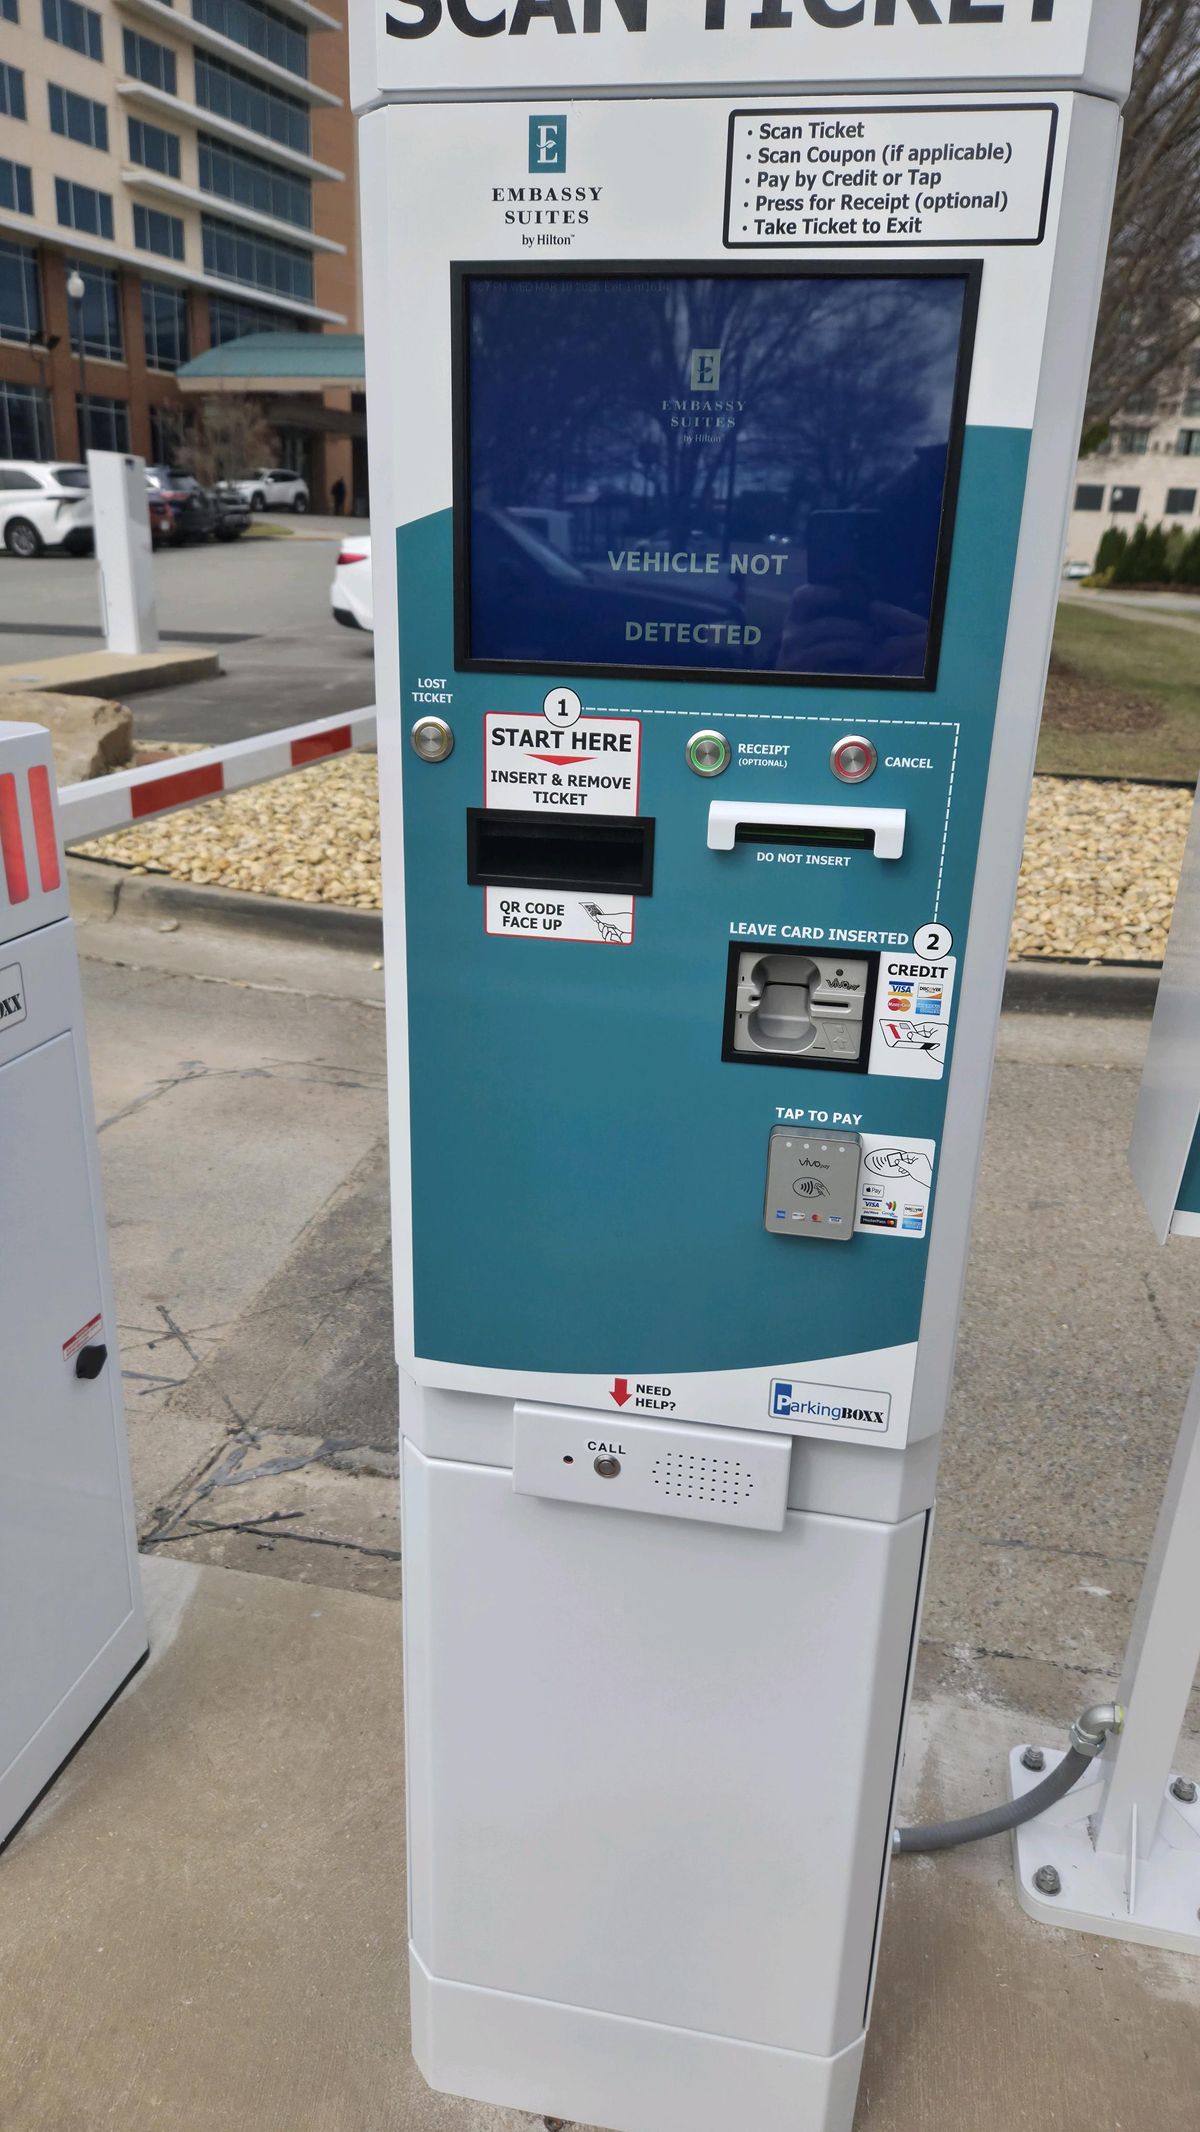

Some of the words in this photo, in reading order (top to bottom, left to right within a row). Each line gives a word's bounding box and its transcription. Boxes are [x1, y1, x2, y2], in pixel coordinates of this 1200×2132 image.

[759, 123, 802, 139] Scan
[809, 121, 865, 138] Ticket
[758, 147, 800, 163] Scan
[807, 145, 876, 166] Coupon
[882, 144, 904, 165] (if
[908, 142, 1013, 165] applicable)
[756, 171, 789, 191] Pay
[796, 170, 817, 191] by
[822, 169, 878, 187] Credit
[883, 173, 903, 187] or
[908, 169, 942, 189] Tap
[492, 187, 603, 201] EMBASSY
[755, 195, 804, 211] Press
[809, 194, 835, 211] for
[841, 193, 910, 213] Receipt
[915, 191, 1008, 213] (optional)
[505, 210, 589, 224] SUITES
[754, 218, 797, 235] Take
[802, 218, 857, 235] Ticket
[863, 218, 881, 234] to
[886, 217, 922, 234] Exit
[522, 234, 535, 248] by
[662, 400, 746, 411] EMBASSY
[671, 416, 736, 428] SUITES
[608, 550, 720, 574] VEHICLE
[730, 553, 789, 576] NOT
[625, 621, 762, 646] DETECTED
[418, 678, 447, 690] LOST
[412, 692, 453, 704] TICKET
[557, 698, 569, 717] 1
[491, 727, 564, 749] START
[572, 732, 632, 752] HERE
[738, 743, 790, 756] RECEIPT
[738, 758, 788, 769] (OPTIONAL)
[885, 757, 933, 769] CANCEL
[490, 770, 547, 786] INSERT
[551, 774, 564, 786] &
[568, 774, 631, 790] REMOVE
[533, 791, 588, 806] TICKET
[757, 852, 774, 862] DO
[778, 854, 803, 864] NOT
[806, 855, 851, 867] INSERT
[500, 900, 520, 915] QR
[525, 902, 565, 916] CODE
[502, 916, 538, 930] FACE
[542, 919, 562, 931] UP
[729, 922, 777, 936] LEAVE
[781, 925, 824, 940] CARD
[828, 928, 909, 945] INSERTED
[926, 933, 939, 950] 2
[887, 963, 948, 979] CREDIT
[892, 985, 911, 993] VISA
[775, 1107, 804, 1119] TAP
[808, 1110, 828, 1123] TO
[833, 1112, 863, 1126] PAY
[635, 1383, 671, 1397] NEED
[635, 1397, 676, 1411] HELP?
[588, 1441, 626, 1455] CALL
